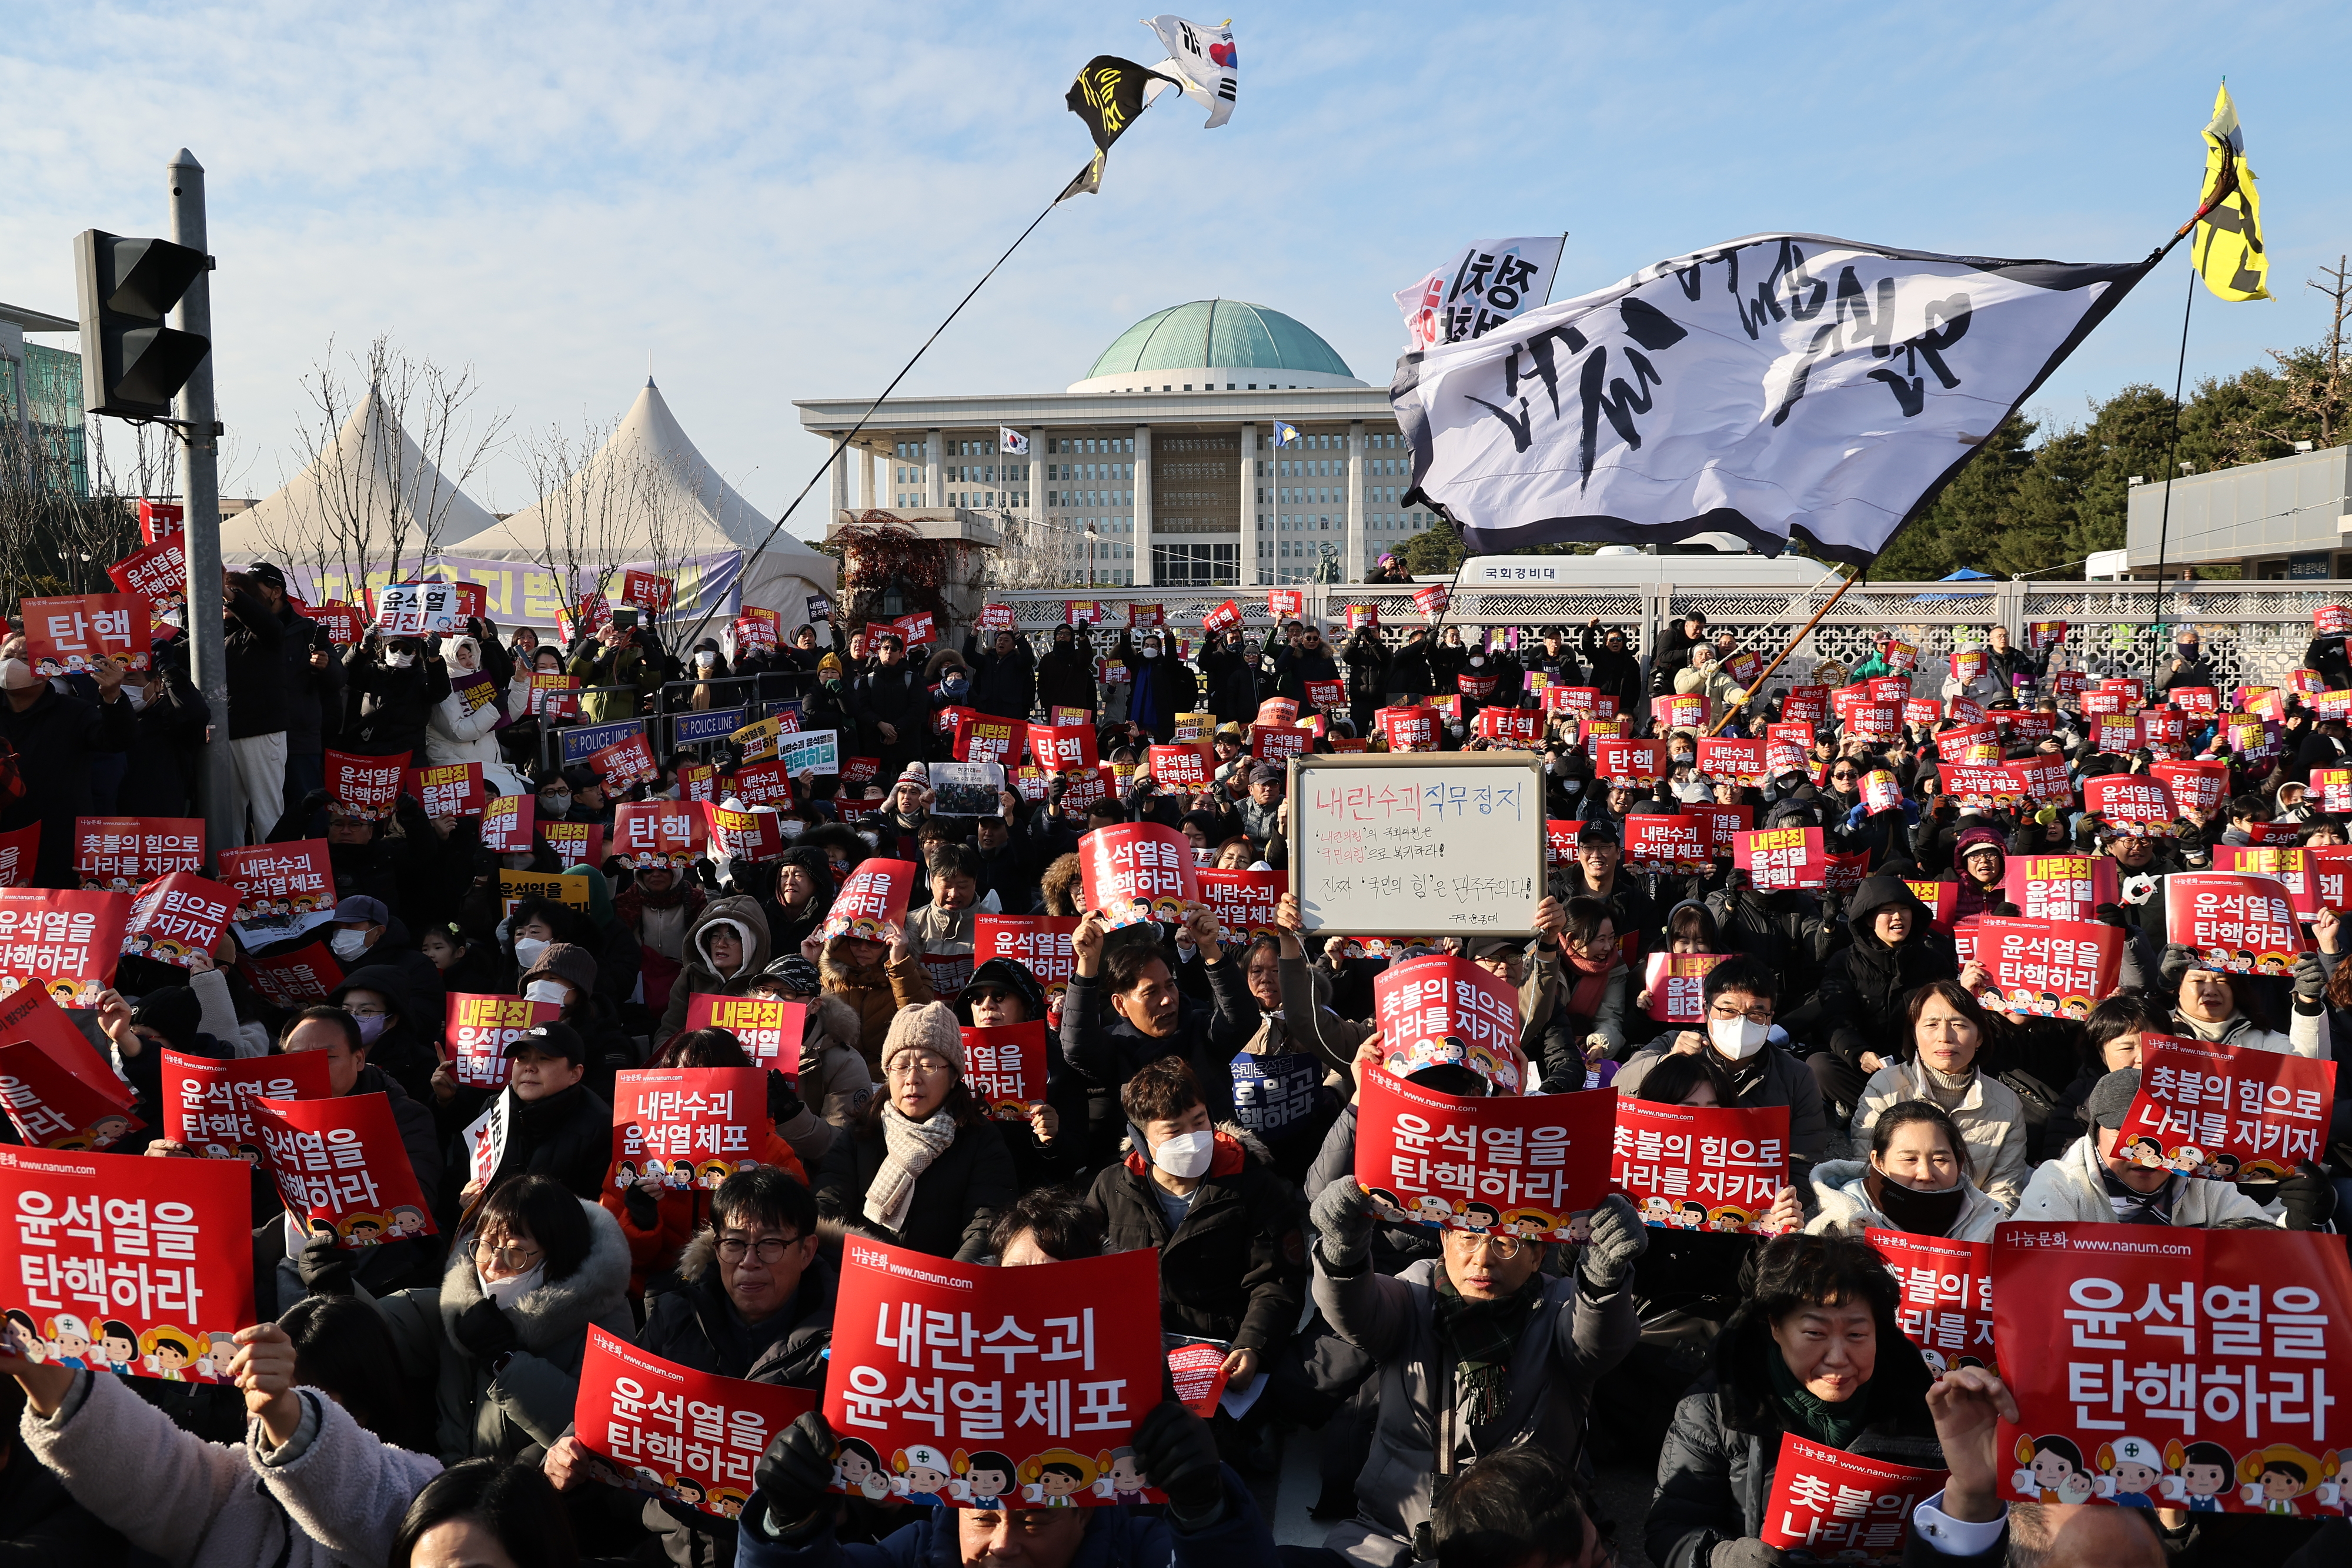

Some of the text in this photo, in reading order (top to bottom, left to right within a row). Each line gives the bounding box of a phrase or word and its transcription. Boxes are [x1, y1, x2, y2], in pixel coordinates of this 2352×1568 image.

[1486, 568, 1555, 580] 국회경비대
[809, 600, 828, 610] 내란범
[48, 609, 132, 651] 탄핵
[379, 612, 429, 631] 퇴진!
[1956, 653, 1980, 663] 내란죄
[1532, 673, 1548, 681] 퇴진
[1823, 672, 1839, 681] 국회
[2060, 677, 2087, 691] 탄핵
[1312, 693, 1339, 702] 탄핵하라
[1560, 690, 1592, 699] 윤석열을
[1878, 683, 1907, 693] 내란수괴
[2019, 688, 2037, 698] 내란범
[2318, 691, 2350, 703] 내란죄
[1560, 698, 1592, 707] 탄핵하라
[1671, 698, 1702, 709] 내란죄
[2087, 695, 2119, 706] 윤석열을
[2087, 704, 2119, 713] 탄핵하라
[2179, 693, 2213, 710] 탄핵
[2318, 700, 2351, 711] 윤석열
[1671, 707, 1702, 717] 윤석열
[1672, 716, 1696, 727] 탄핵!
[1854, 708, 1895, 720] 윤석열을
[2100, 714, 2136, 728] 내란죄
[691, 715, 733, 735] POLICE LINE
[971, 724, 1011, 740] 내란죄
[1394, 718, 1431, 731] 윤석열을
[1496, 716, 1534, 737] 탄핵
[1588, 723, 1621, 734] 내란죄
[1854, 720, 1895, 732] 탄핵하라
[2100, 727, 2136, 740] 윤석열
[2145, 718, 2183, 741] 탄핵
[2240, 722, 2264, 737] 퇴진
[580, 730, 628, 751] POLICE LINE
[780, 734, 835, 755] 내란수괴 윤석열을
[970, 737, 1010, 754] 윤석열
[1264, 733, 1304, 746] 윤석열을
[1395, 730, 1432, 744] 탄핵하라
[1940, 730, 1996, 748] 촛불의 힘으로
[2099, 738, 2128, 752] 탄핵!
[2242, 731, 2276, 750] 광장을
[604, 743, 643, 768] 내란수괴
[781, 744, 836, 774] 탄핵하라
[1037, 737, 1083, 766] 탄핵
[1155, 753, 1202, 768] 윤석열을
[1608, 748, 1654, 774] 탄핵
[1709, 747, 1755, 760] 내란수괴
[1965, 745, 2000, 760] 내란죄
[2244, 745, 2270, 761] 열자!
[340, 765, 401, 786] 윤석열을
[420, 764, 469, 787] 내란죄
[1156, 767, 1204, 783] 탄핵하라
[1702, 760, 1762, 773] 윤석열 체포
[743, 771, 779, 789] 내란수괴
[1950, 778, 2021, 792] 윤석열 체포
[340, 784, 398, 805] 탄핵하라
[422, 781, 470, 804] 윤석열
[741, 784, 787, 804] 윤석열 체포
[2100, 785, 2164, 803] 윤석열을
[2102, 802, 2169, 821] 탄핵하라
[545, 824, 589, 840] 내란죄
[629, 814, 691, 848] 탄핵
[1641, 826, 1698, 843] 내란수괴
[1749, 828, 1806, 852] 내란죄
[82, 834, 200, 854] 촛불의 힘으로
[1633, 843, 1705, 858] 윤석열 체포
[81, 855, 140, 875] 나라를
[240, 852, 312, 879] 내란수괴
[1750, 847, 1808, 868] 윤석열
[2235, 850, 2304, 872] 내란죄
[1753, 866, 1796, 890] 탄핵!
[2026, 858, 2093, 881] 내란죄
[289, 872, 325, 893] 체포
[1319, 875, 1352, 902] 진짜
[1452, 874, 1532, 904] 민주주의다!
[2026, 880, 2093, 902] 윤석열
[1205, 884, 1274, 905] 내란수괴
[165, 890, 228, 924] 힘으로
[2193, 892, 2290, 924] 윤석열을
[2194, 921, 2295, 952] 탄핵하라
[2000, 934, 2100, 968] 윤석열을
[1999, 961, 2099, 997] 탄핵하라
[5, 998, 39, 1027] 밝았다
[459, 999, 534, 1028] 내란죄
[1382, 977, 1515, 1030] 촛불의 힘으로
[711, 1001, 783, 1029] 내란죄
[1384, 1006, 1451, 1047] 나라를
[2180, 1047, 2234, 1061] www.nanum.com
[456, 1056, 506, 1085] 탄핵!
[1263, 1067, 1315, 1104] 말고
[2150, 1066, 2323, 1121] 촛불의 힘으로
[637, 1090, 733, 1122] 내란수괴
[1638, 1107, 1694, 1121] www.nanum.com
[623, 1125, 749, 1156] 윤석열 체포
[1391, 1113, 1571, 1166] 윤석열을
[2139, 1104, 2320, 1166] 나라를 지키자
[262, 1128, 365, 1175] 윤석열을
[1700, 1135, 1784, 1169] 힘으로
[19, 1159, 96, 1176] www.nanum.com
[1391, 1154, 1569, 1208] 탄핵하라
[15, 1190, 200, 1260] 윤석열을
[1909, 1243, 1972, 1258] www.nanum.com
[2006, 1230, 2192, 1256] 나눔문화 www.nanum.com
[889, 1263, 973, 1290] www.nanum.com
[19, 1253, 203, 1325] 탄핵하라
[2063, 1277, 2328, 1359] 윤석열을
[875, 1299, 1095, 1372] 내란수괴
[842, 1365, 1132, 1440] 윤석열 체포
[2067, 1359, 2335, 1442] 탄핵하라
[610, 1376, 768, 1453] 윤석열을
[1781, 1473, 1915, 1548] 촛불의 나라를
